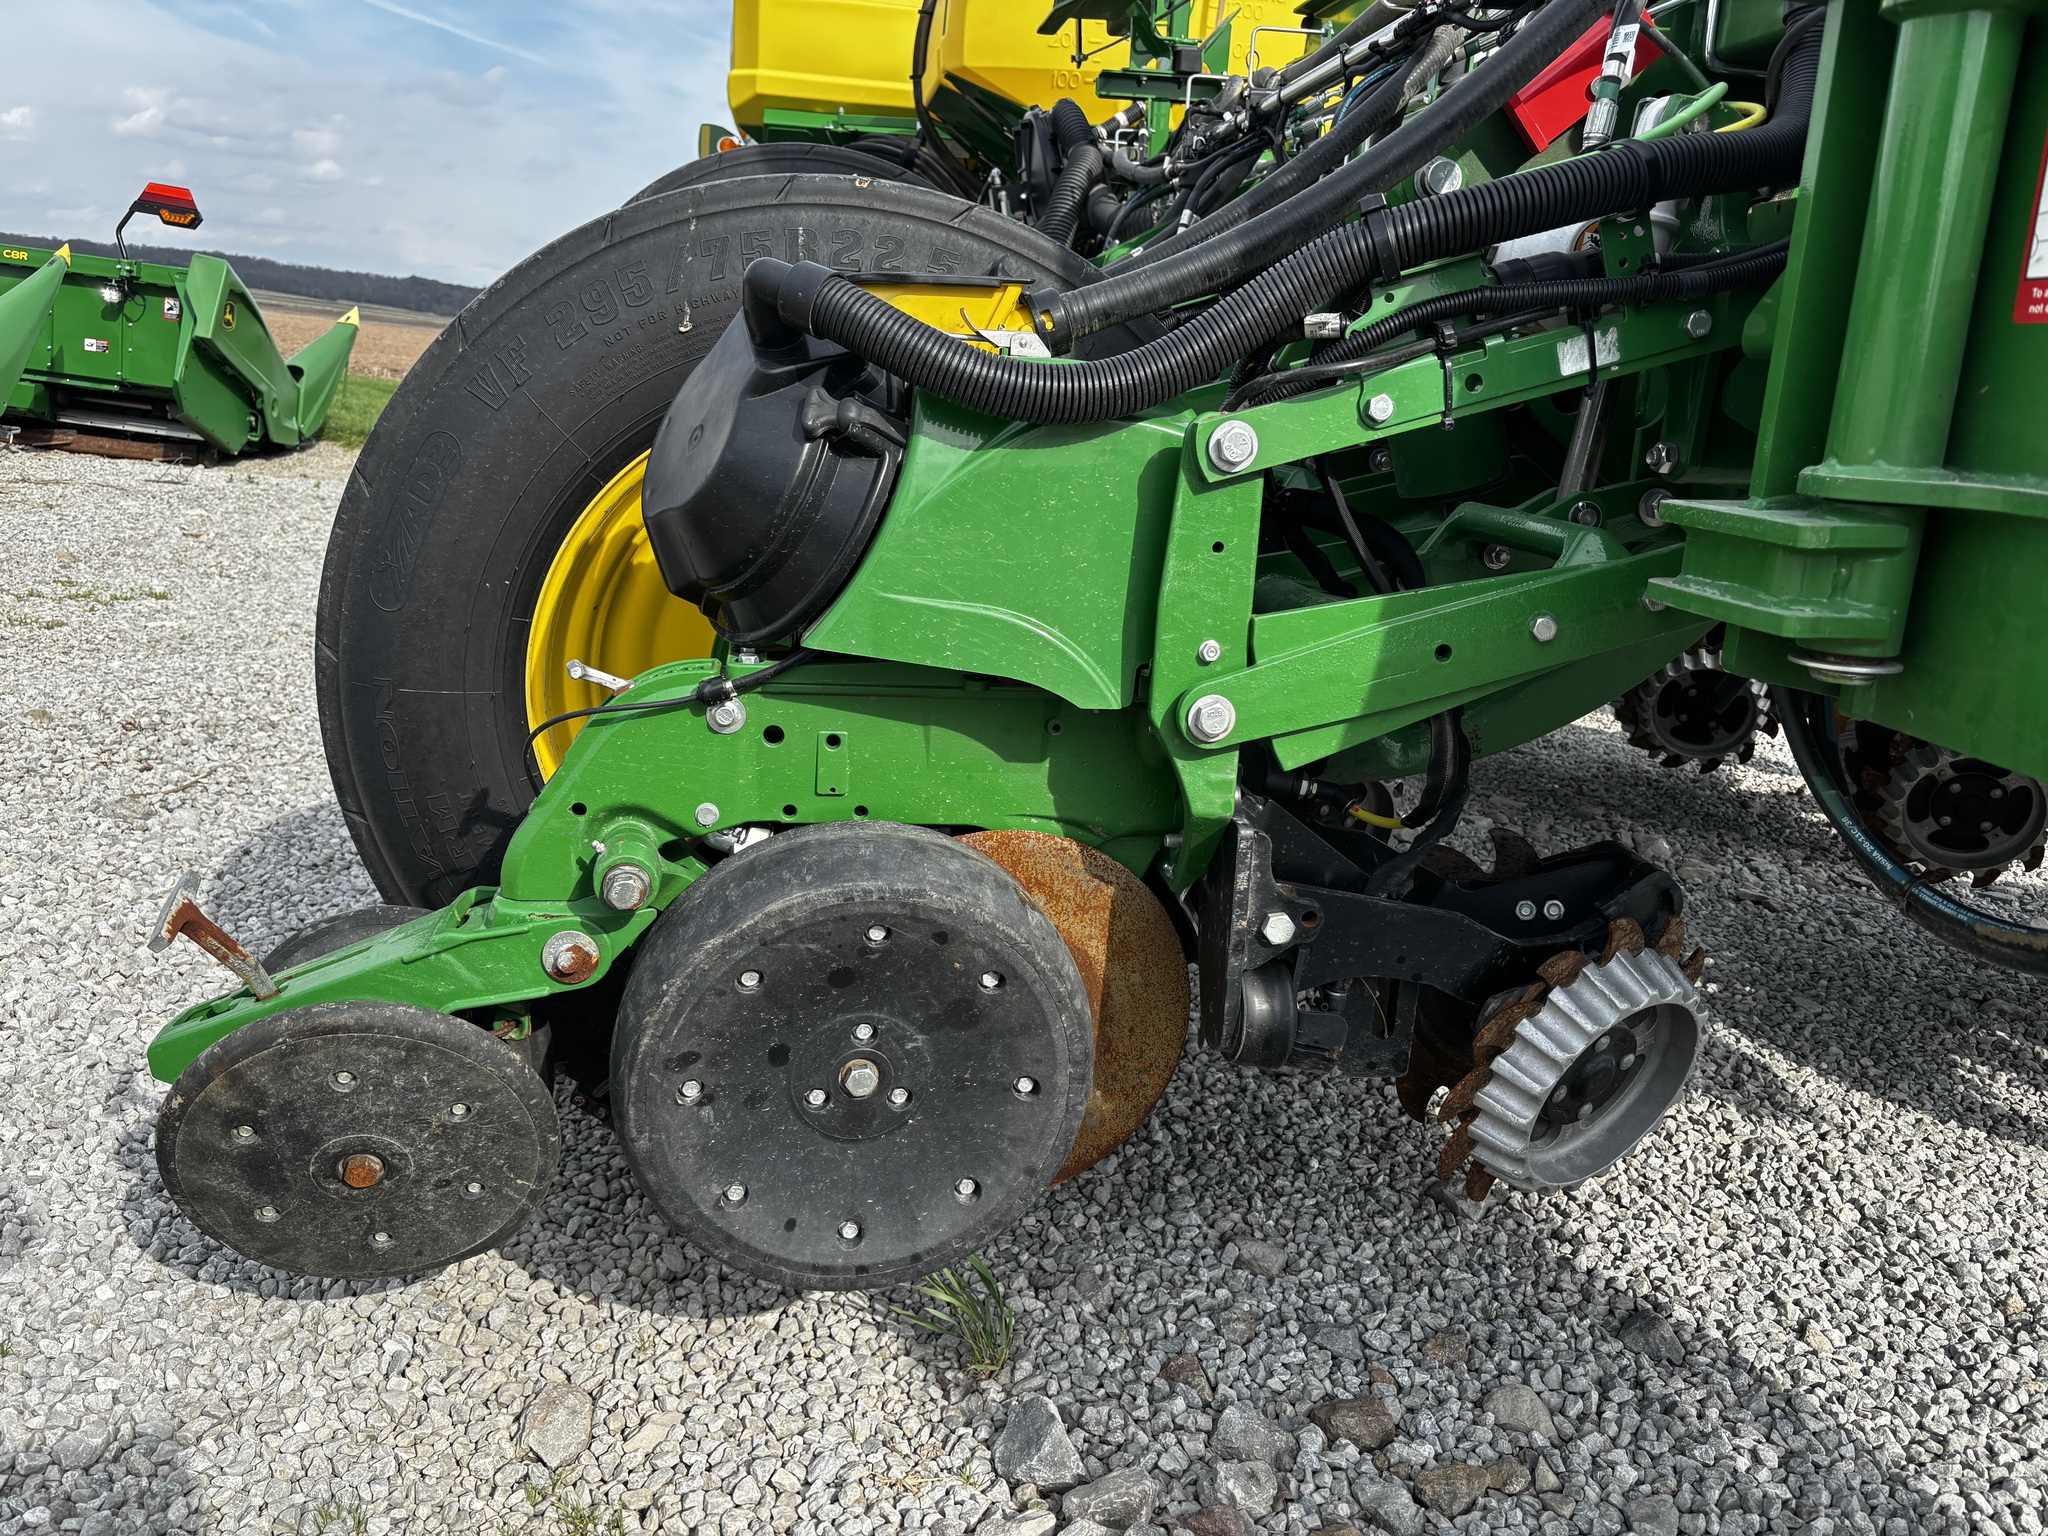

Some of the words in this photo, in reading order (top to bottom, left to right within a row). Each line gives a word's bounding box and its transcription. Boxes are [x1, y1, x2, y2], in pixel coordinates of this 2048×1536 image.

[1051, 70, 1081, 89] 100
[2032, 287, 2043, 298] To
[2028, 303, 2044, 314] not
[603, 326, 631, 347] NOT
[638, 310, 668, 330] FOR
[464, 334, 533, 412] VF
[569, 370, 600, 397] SAFETY
[373, 676, 453, 904] NATION
[1873, 849, 1893, 871] MSHA
